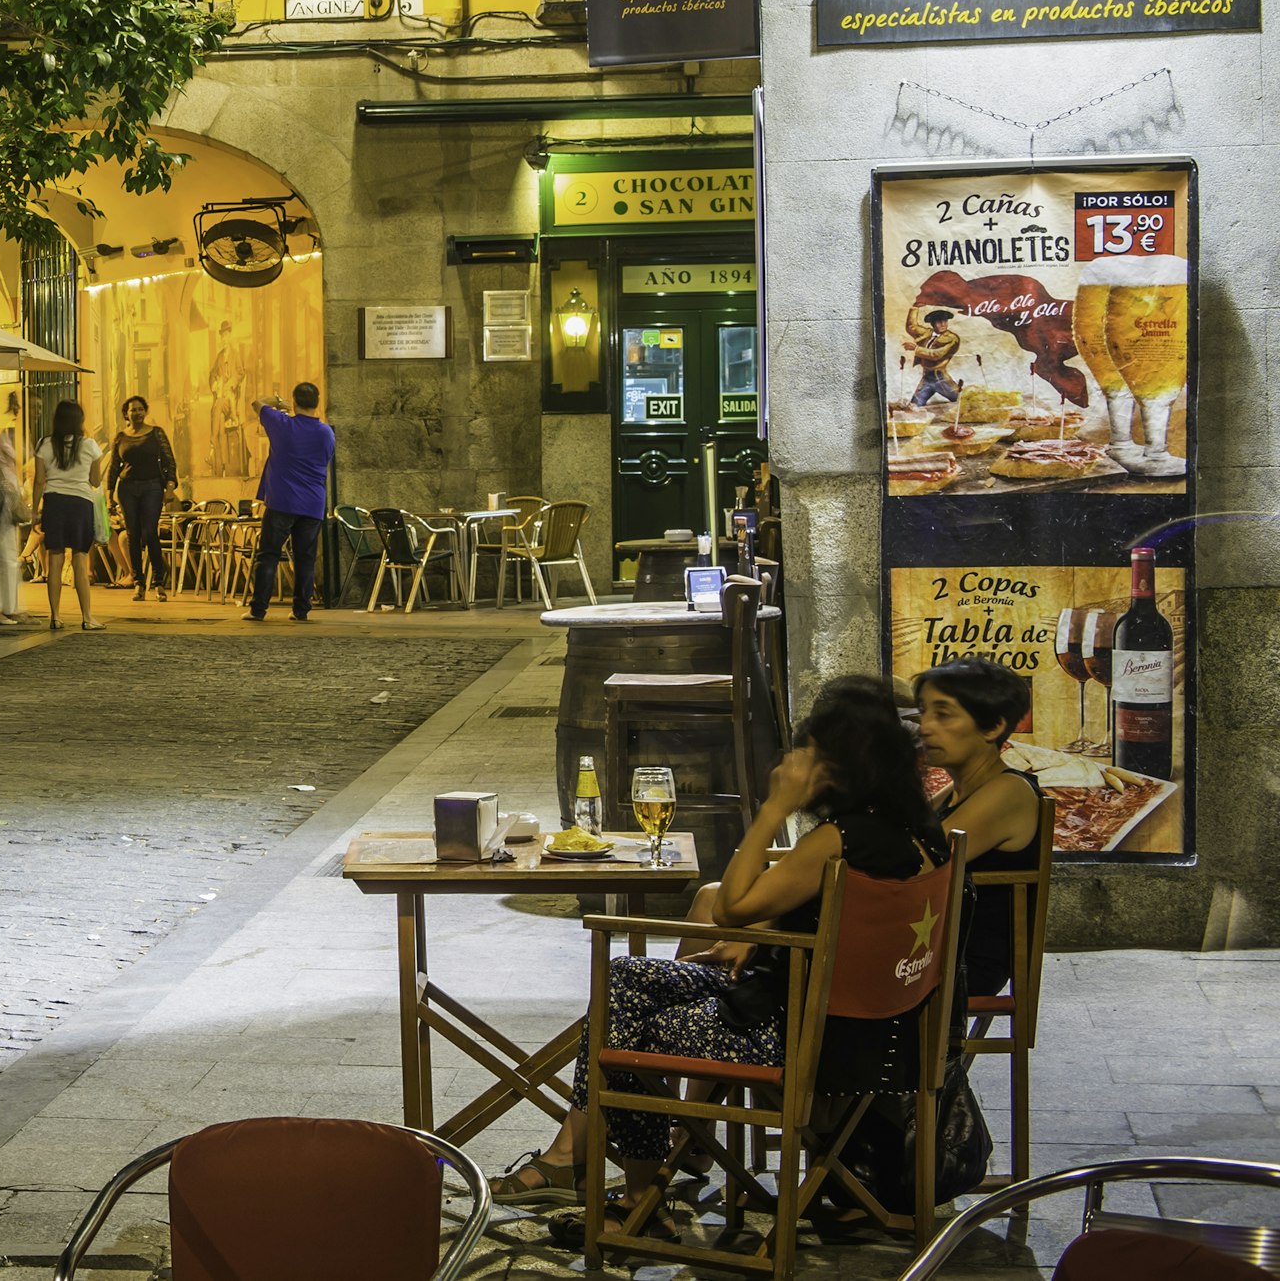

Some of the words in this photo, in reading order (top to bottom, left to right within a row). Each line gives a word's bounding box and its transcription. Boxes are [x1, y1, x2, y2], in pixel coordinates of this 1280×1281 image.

[289, 2, 315, 17] SAN
[622, 2, 677, 19] productos
[681, 0, 726, 12] ibéricos
[841, 3, 982, 35] especialistas
[991, 5, 1017, 22] en
[613, 174, 753, 194] CHOCOLAT
[575, 191, 587, 206] 2
[640, 198, 694, 215] SAN
[1123, 193, 1168, 206] SÓLO!
[936, 201, 952, 223] 2
[962, 193, 1044, 218] Cañas
[901, 239, 923, 267] 8
[927, 236, 1070, 266] MANOLETES
[645, 267, 692, 285] AÑO
[710, 269, 753, 284] 1894
[1009, 294, 1035, 310] Ole
[1014, 310, 1032, 326] y
[1033, 302, 1068, 318] Ole!
[1135, 316, 1177, 329] Estrella
[650, 400, 678, 415] EXIT
[723, 400, 756, 413] SALIDA
[932, 577, 949, 601] 2
[959, 571, 1041, 598] Copas
[957, 597, 971, 607] de
[973, 595, 1015, 606] Beronia
[924, 617, 1014, 644] Tabla
[1021, 625, 1048, 643] de
[1121, 659, 1162, 678] Beronia
[895, 950, 934, 979] Estrella
